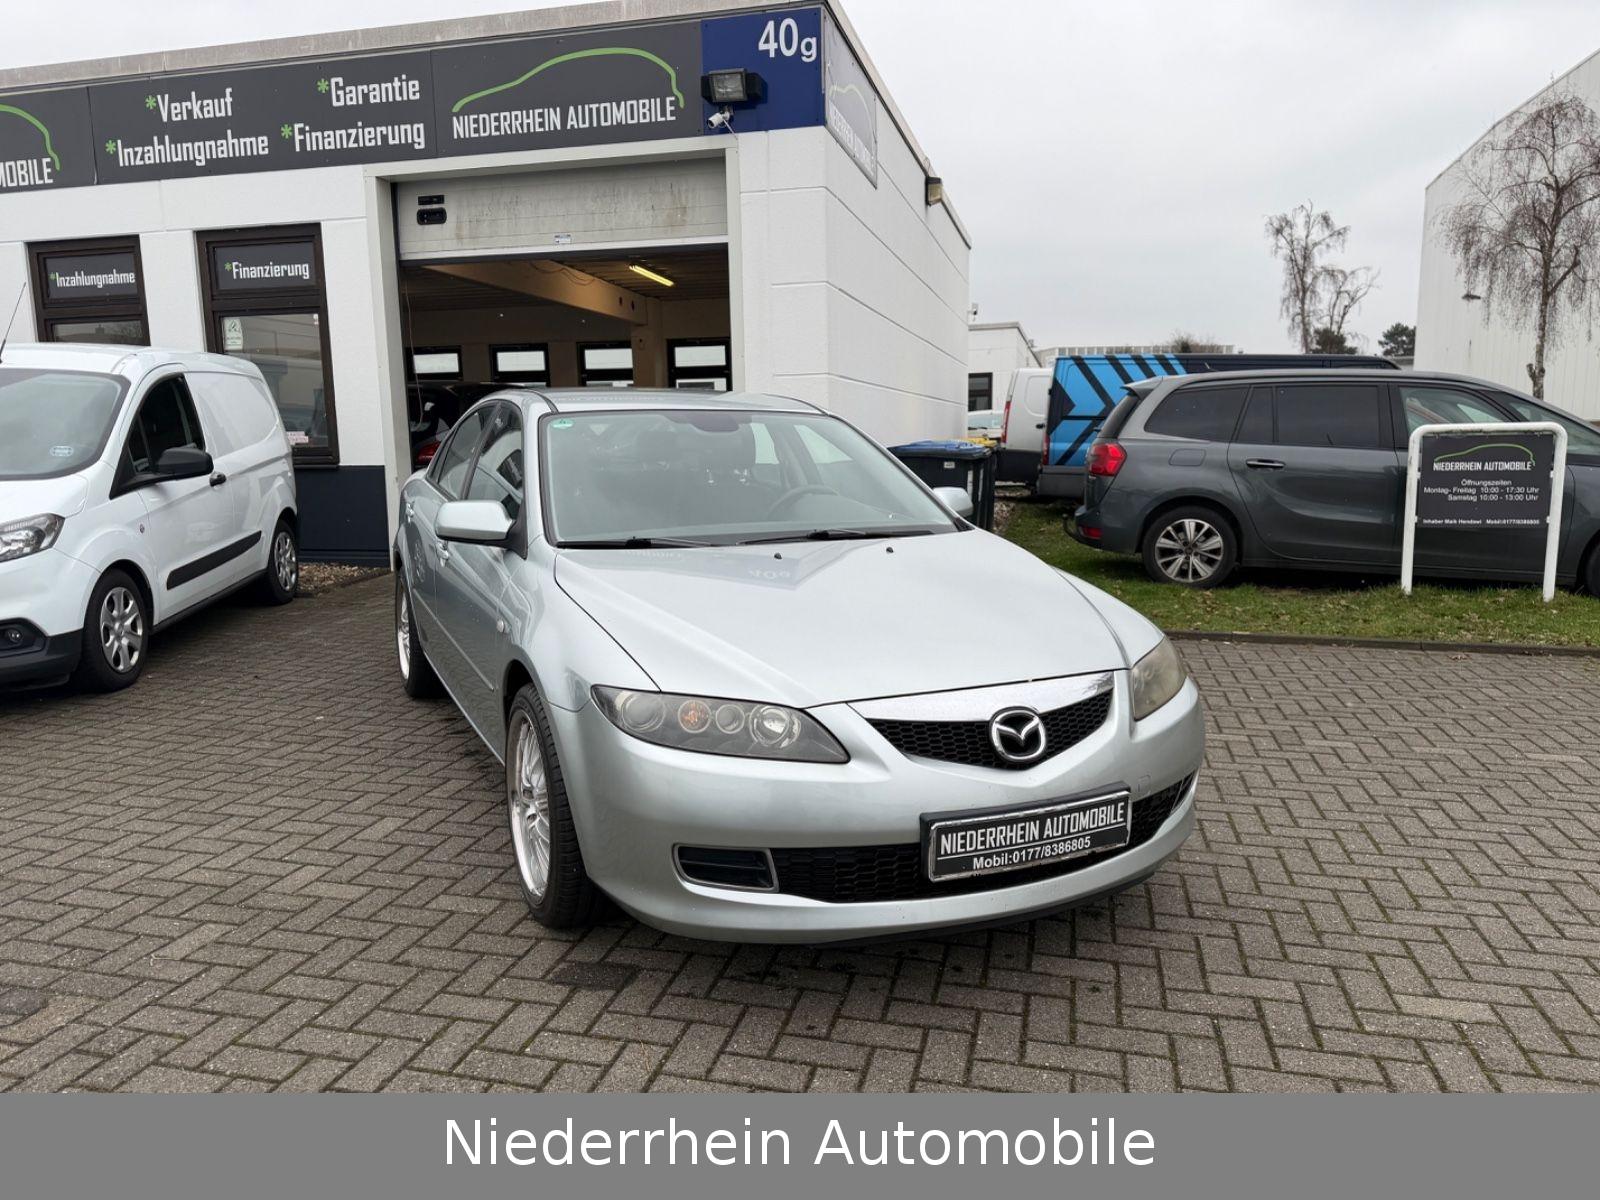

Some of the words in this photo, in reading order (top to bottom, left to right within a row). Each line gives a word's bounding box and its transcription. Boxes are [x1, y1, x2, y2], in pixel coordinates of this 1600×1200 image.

[758, 17, 817, 63] 40g
[452, 107, 562, 140] NIEDERRHEIN
[566, 96, 677, 130] AUTOMOBILE
[1433, 461, 1482, 471] NIEDERRHEIN
[1484, 461, 1532, 471] AUTOMOBILE
[1453, 487, 1476, 495] Freitag
[1461, 478, 1512, 487] Öffnungszeiten
[1448, 494, 1477, 502] Samstag
[940, 820, 1040, 855] NIEDERRHEIN
[1043, 801, 1125, 839] AUTOMOBILE
[972, 836, 1091, 870] Mobil:0177/8386805
